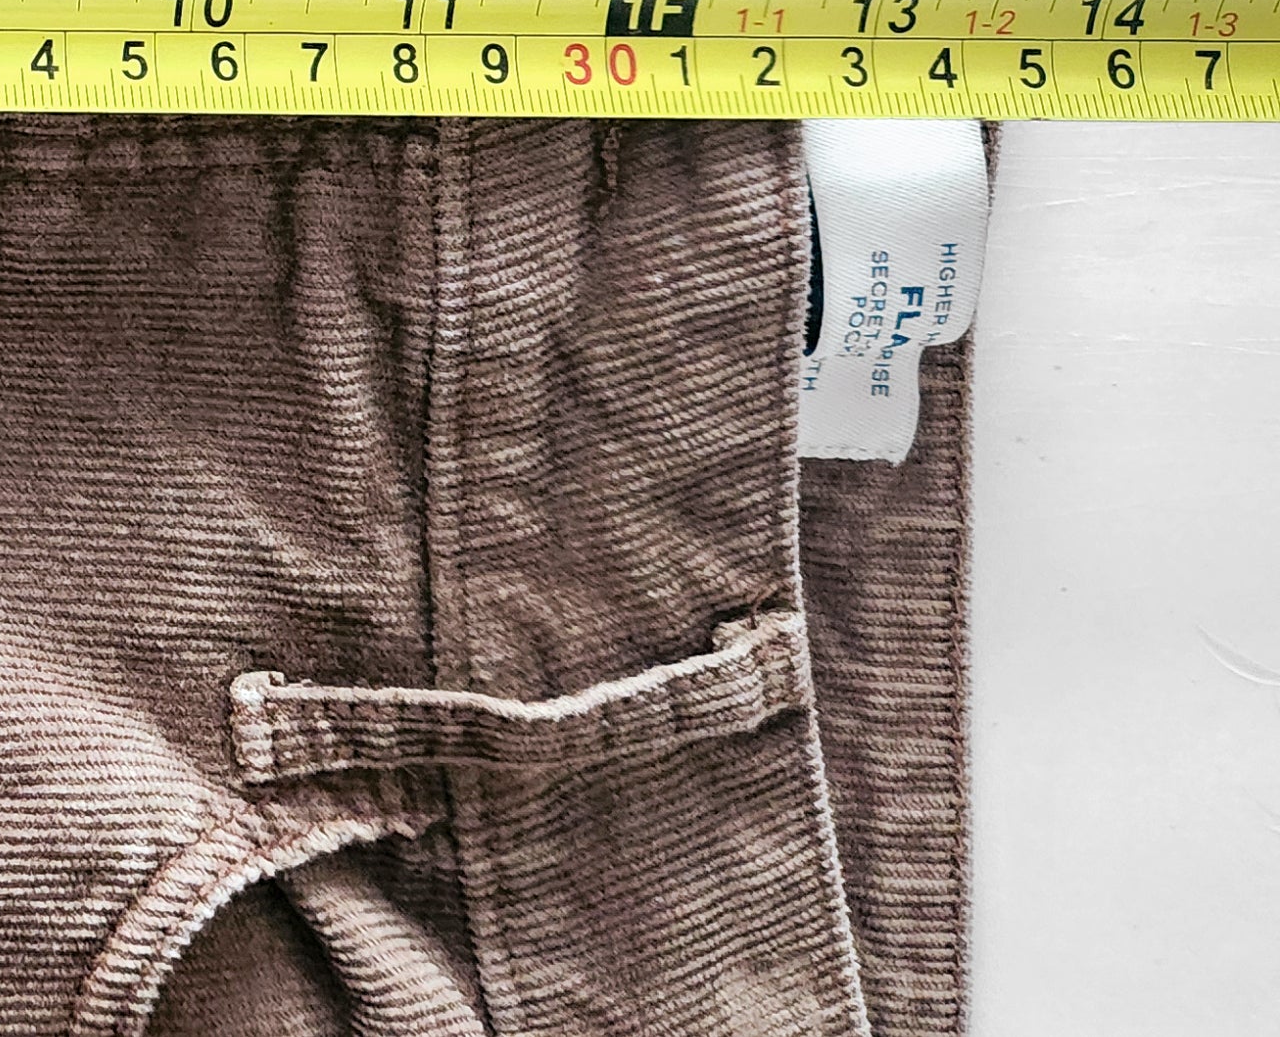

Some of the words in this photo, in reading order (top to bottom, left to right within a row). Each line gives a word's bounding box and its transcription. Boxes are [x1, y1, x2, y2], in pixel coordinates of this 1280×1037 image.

[738, 9, 785, 33] 1-1
[964, 11, 1016, 35] 1-2
[1189, 12, 1238, 37] 1-3
[30, 40, 60, 80] 4
[122, 41, 148, 80] 5
[211, 42, 238, 81] 6
[302, 43, 329, 82] 7
[393, 43, 419, 83] 8
[482, 43, 508, 83] 9
[565, 43, 637, 85] 30
[671, 46, 689, 86] 1
[753, 46, 780, 86] 2
[841, 47, 868, 87] 3
[928, 48, 958, 88] 4
[1020, 49, 1046, 88] 5
[1108, 49, 1135, 89] 6
[1195, 51, 1221, 90] 7
